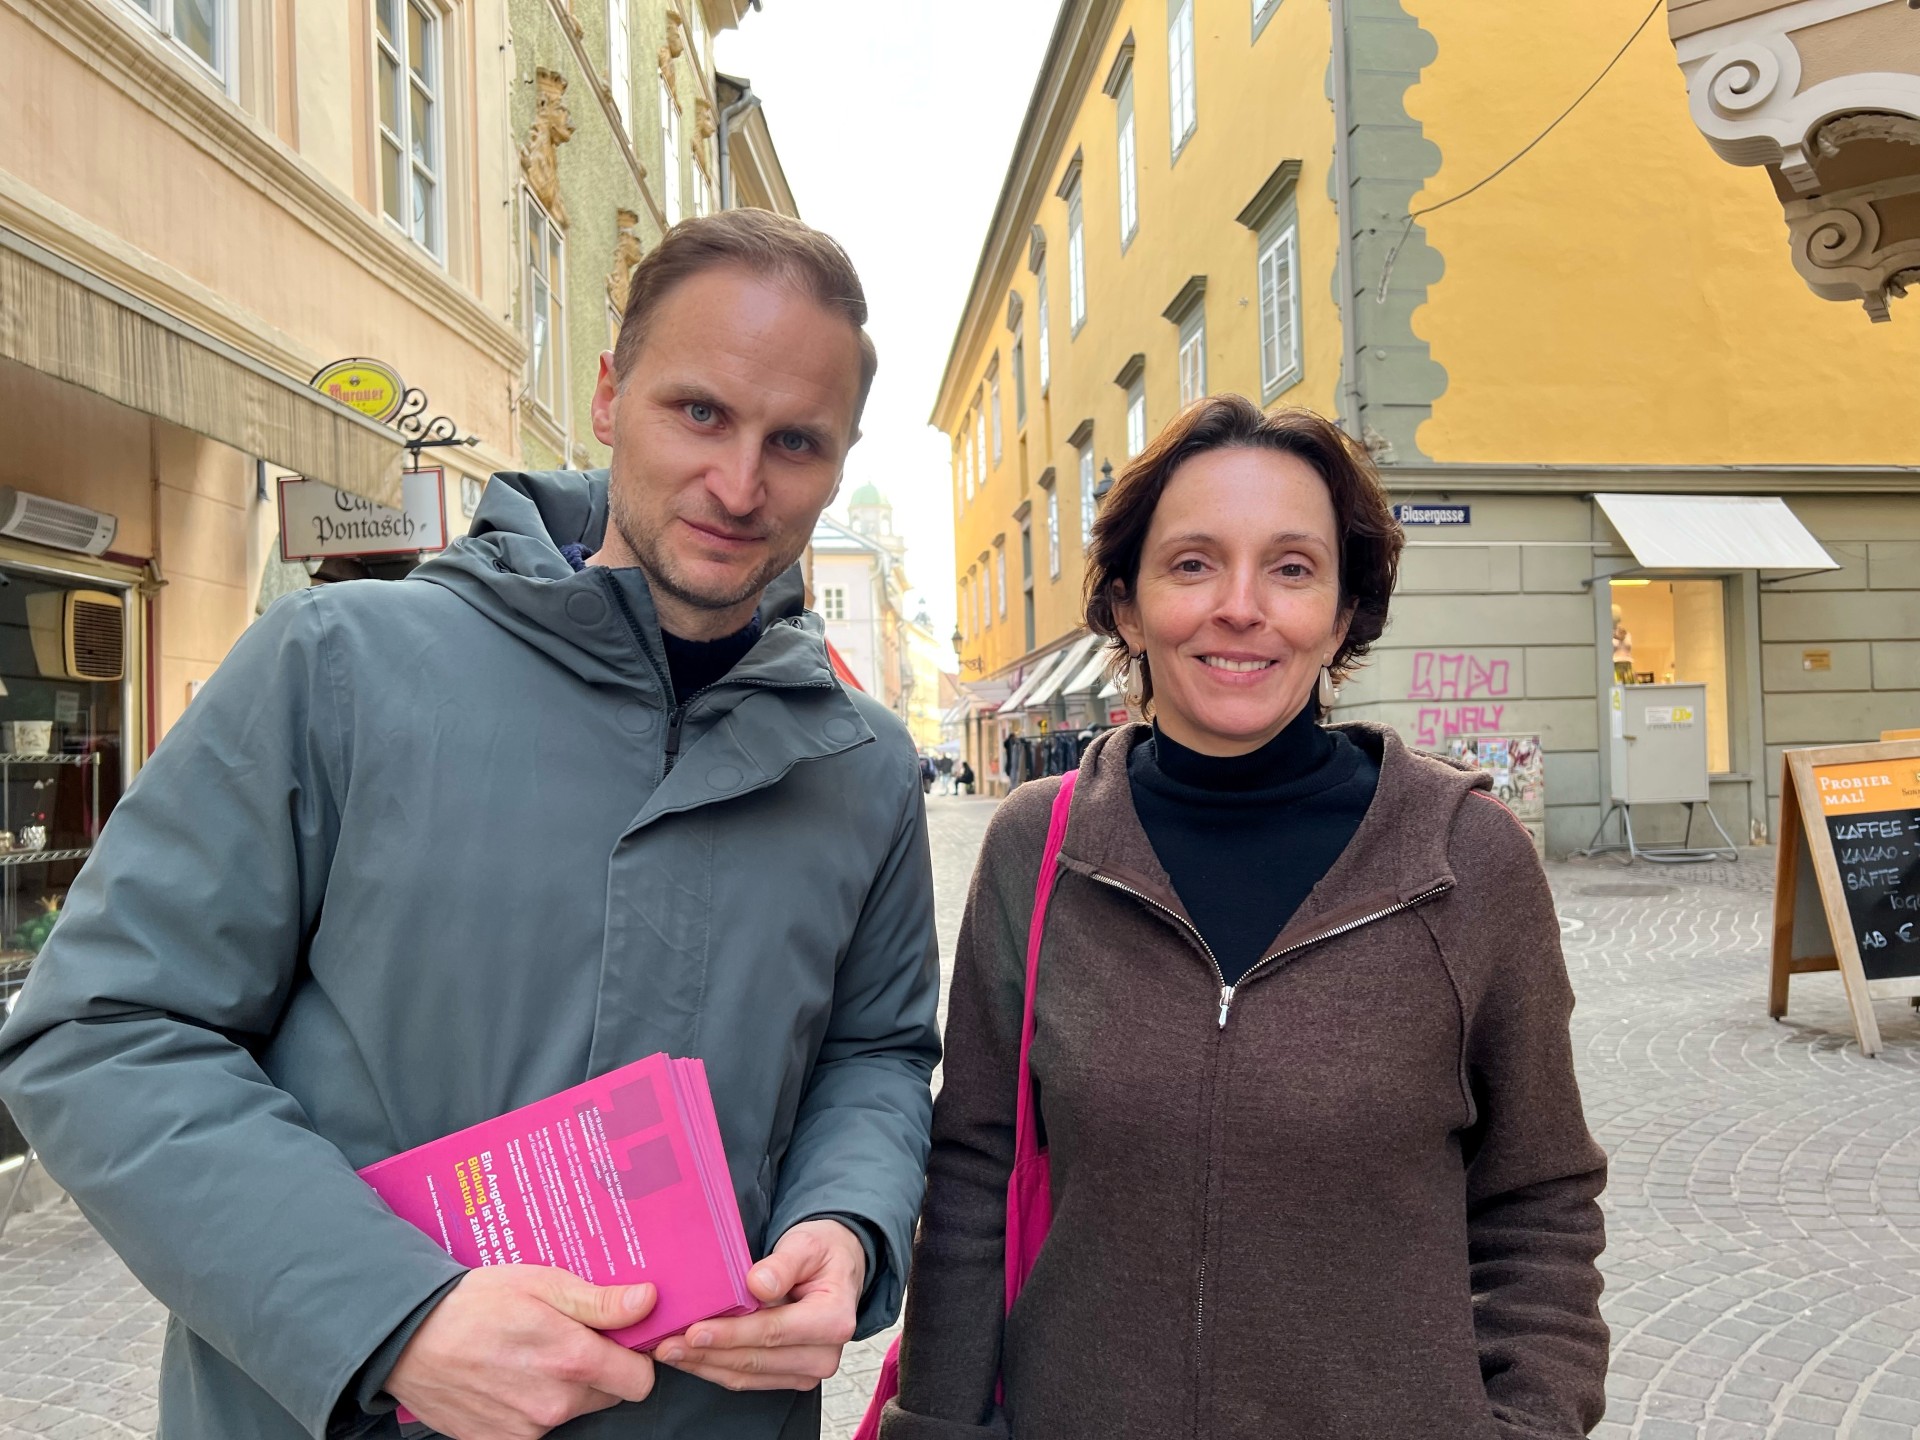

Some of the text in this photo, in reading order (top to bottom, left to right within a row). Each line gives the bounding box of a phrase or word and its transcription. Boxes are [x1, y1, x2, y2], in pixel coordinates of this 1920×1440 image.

[1401, 505, 1465, 525] Glasergasse
[312, 511, 415, 546] Pontasch
[1836, 820, 1903, 840] KAFFEE
[1841, 846, 1898, 865] KAKAO
[1847, 867, 1901, 890] SÄFTE
[1862, 930, 1888, 950] AB
[513, 1139, 525, 1168] Deswegen
[468, 1157, 486, 1204] Bildung
[545, 1164, 555, 1189] Leistung
[454, 1161, 475, 1215] Leistung
[469, 1216, 486, 1248] zahlt
[480, 1151, 522, 1263] Ein Angebot das kl
[481, 1204, 493, 1222] ist
[525, 1205, 536, 1229] Angebot
[486, 1222, 500, 1247] was
